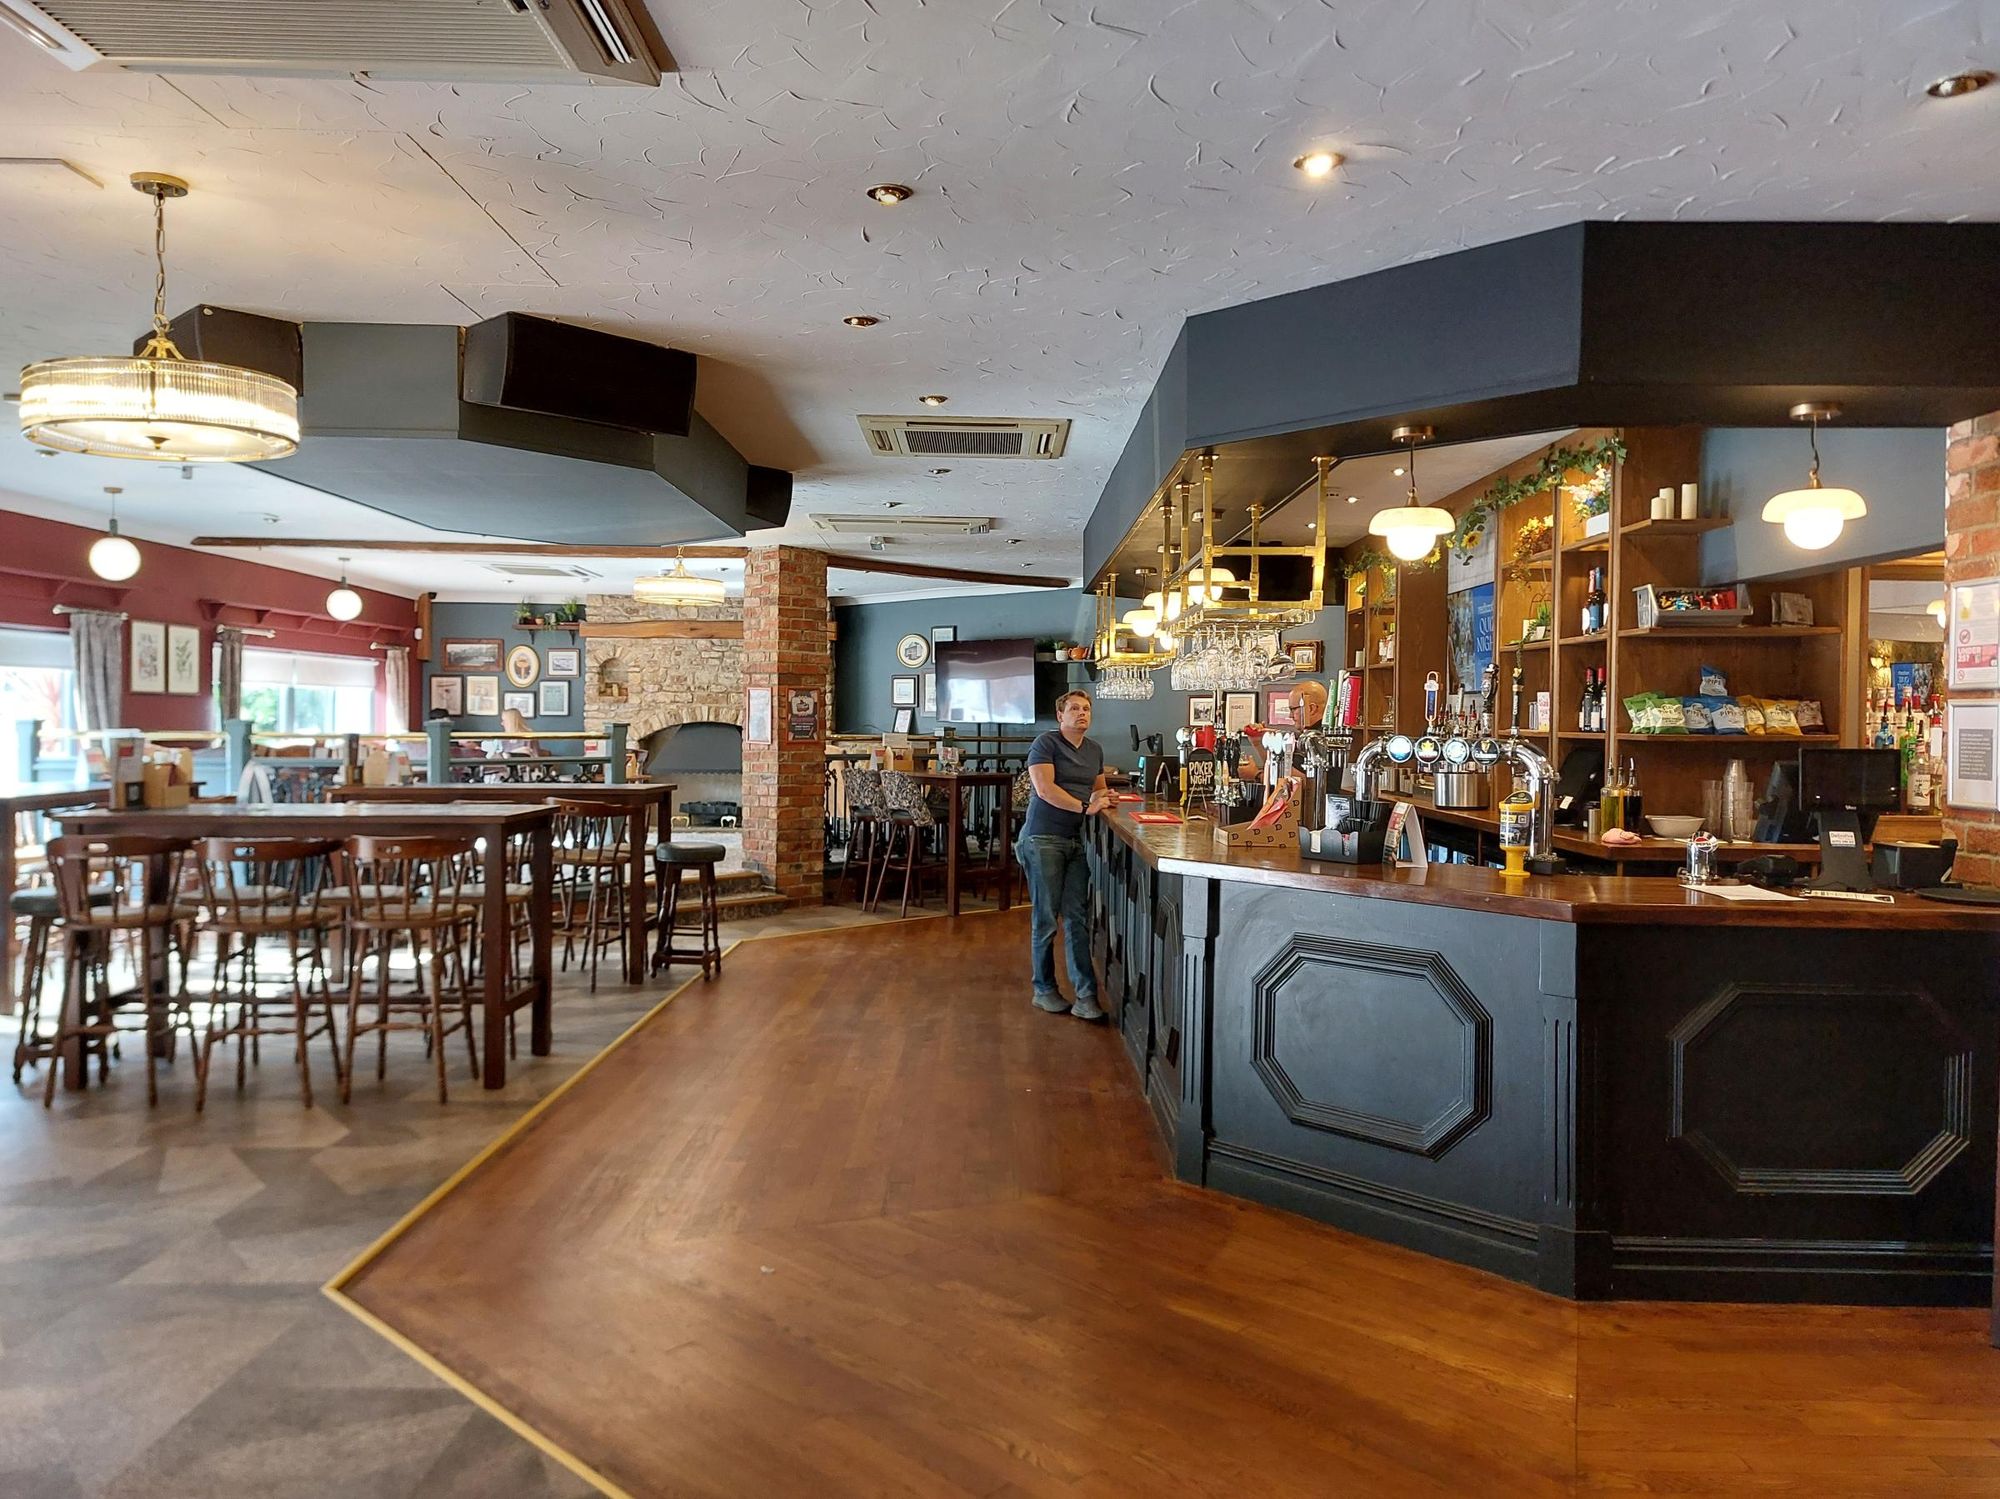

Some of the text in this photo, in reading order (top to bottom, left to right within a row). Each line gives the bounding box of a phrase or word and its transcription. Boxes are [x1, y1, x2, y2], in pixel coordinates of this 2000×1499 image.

[1480, 617, 1494, 636] QUI
[1477, 635, 1494, 653] NIGH
[1189, 761, 1213, 776] POKER
[1190, 775, 1212, 785] NIGHT
